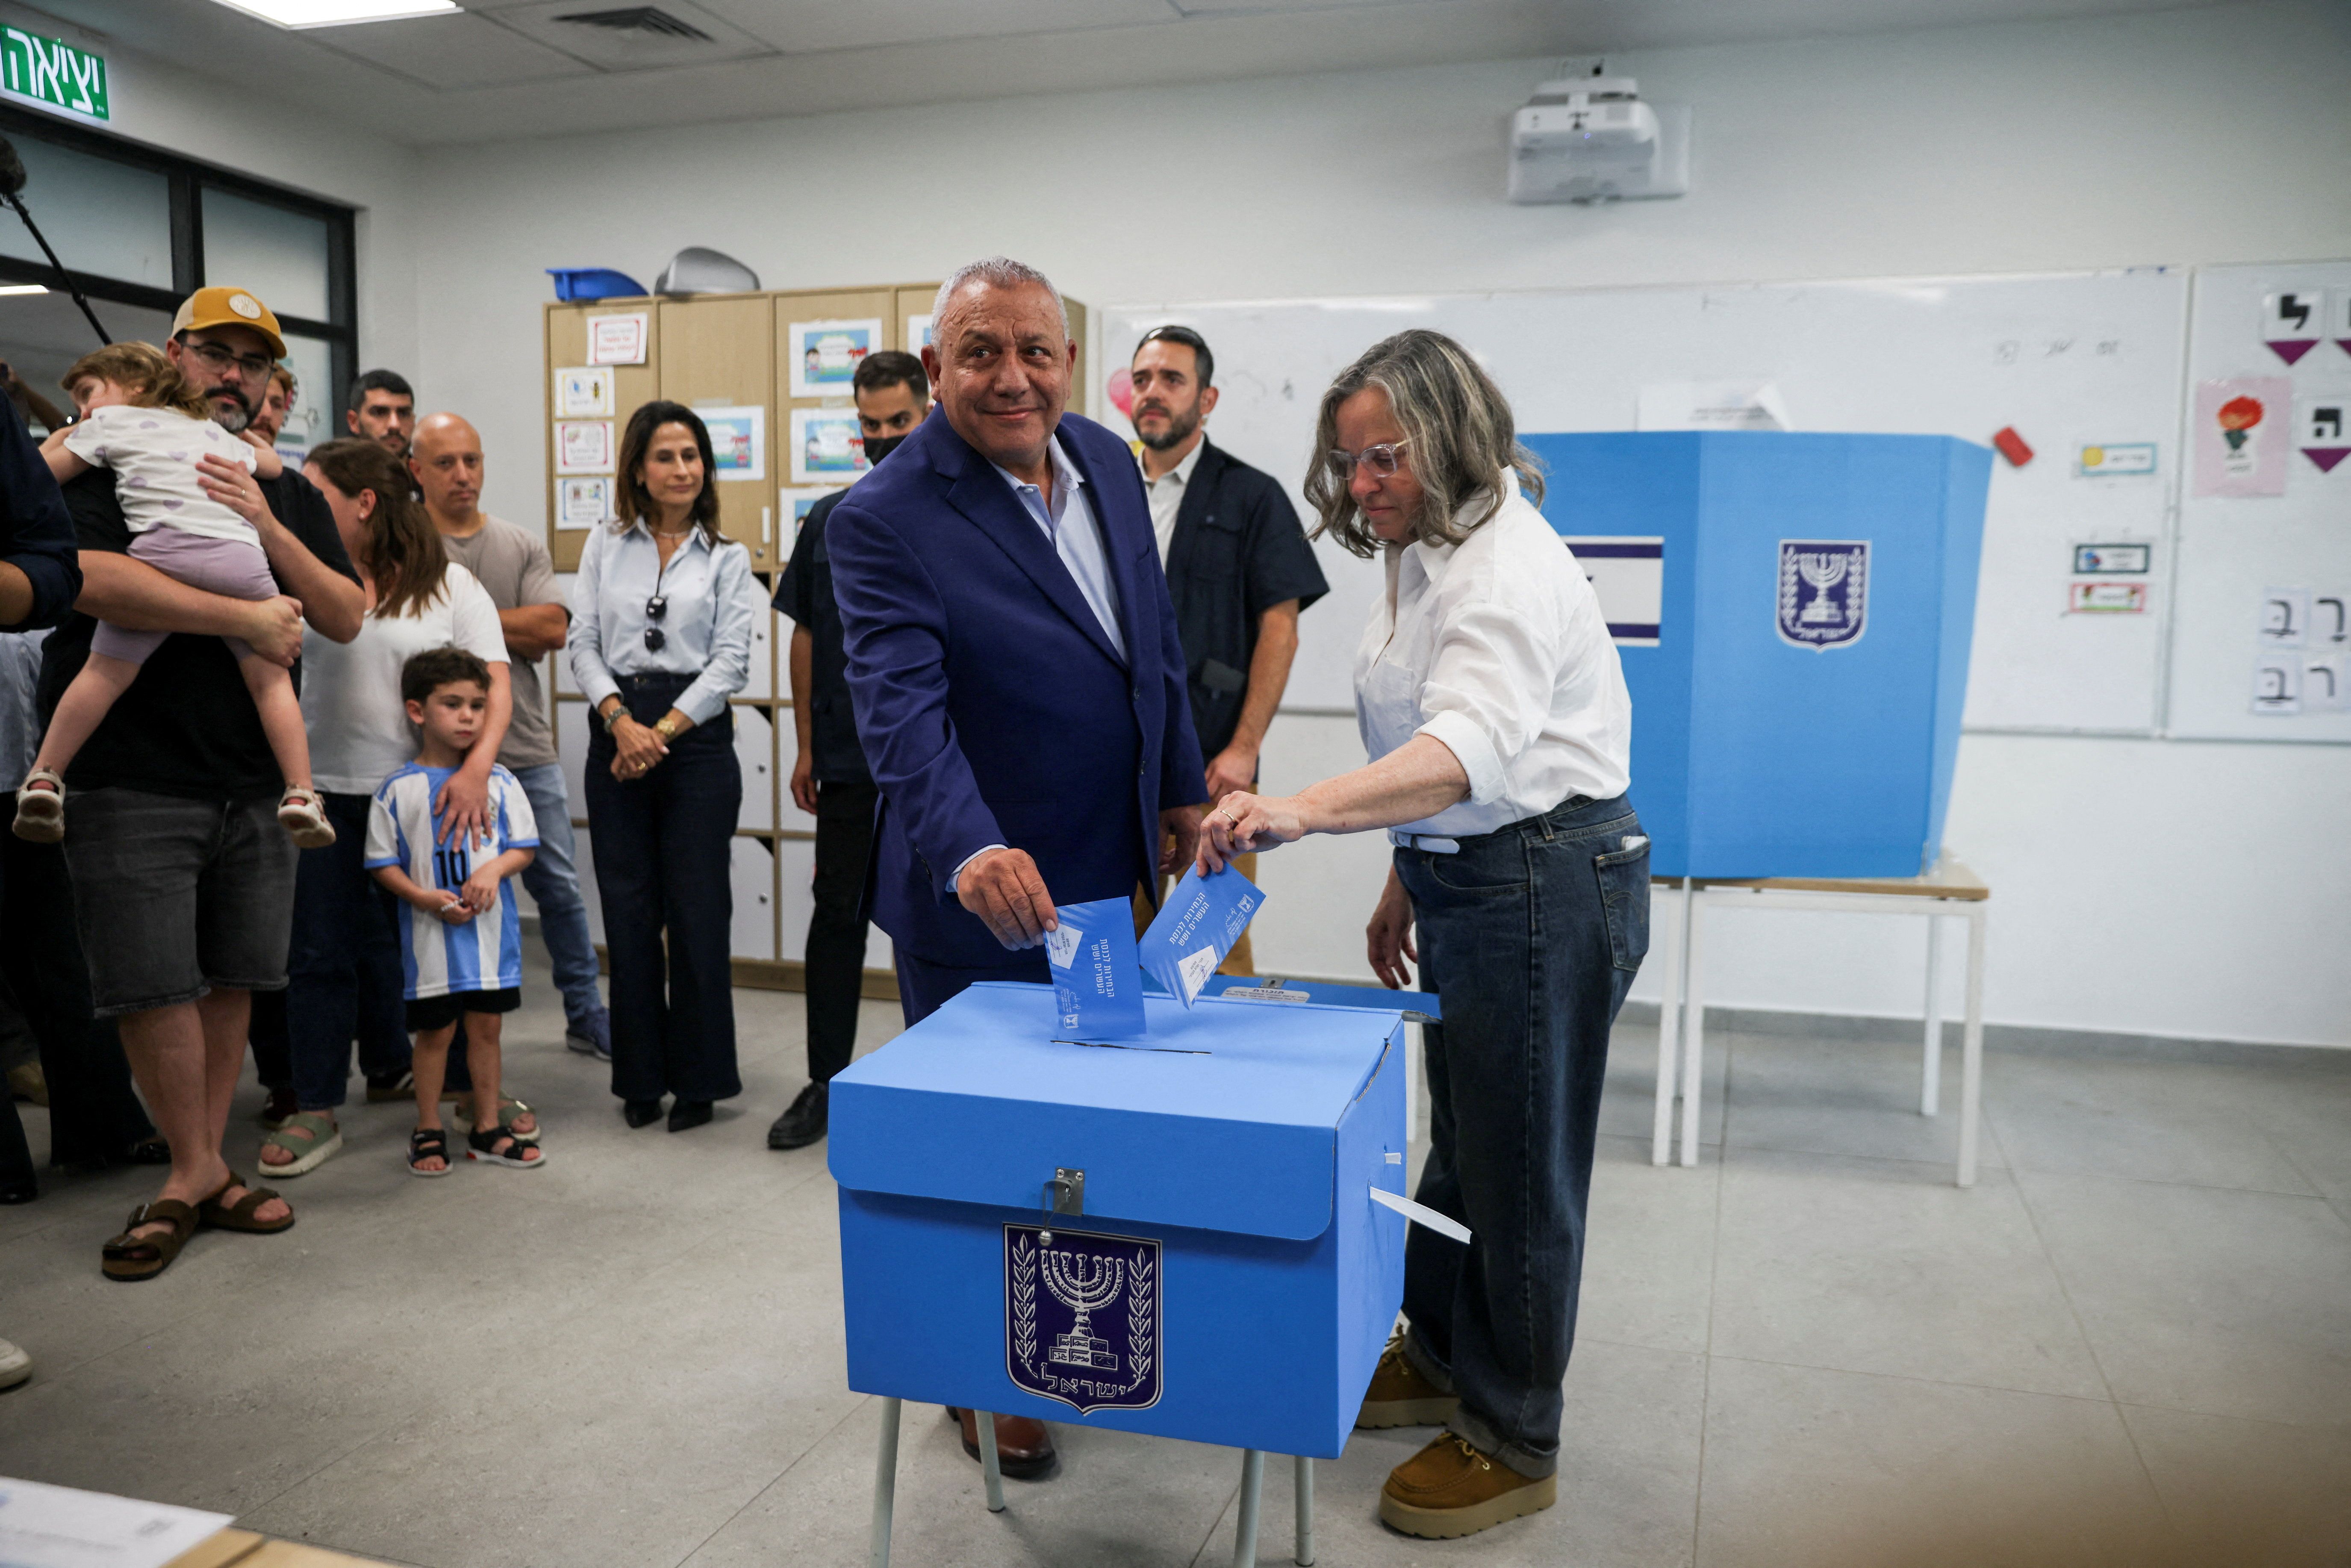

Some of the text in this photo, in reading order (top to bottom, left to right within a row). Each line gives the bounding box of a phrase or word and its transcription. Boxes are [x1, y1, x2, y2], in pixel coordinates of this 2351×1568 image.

[7, 28, 100, 115] יציאה
[2280, 295, 2310, 330] ל
[2313, 408, 2341, 437] ה
[435, 849, 466, 888] 10
[1169, 892, 1205, 945] הבחירות לכנסת
[1178, 902, 1210, 946] העשרים ושש
[1091, 944, 1105, 994] העשרים ושש
[1099, 938, 1114, 997] הבחירות לכנסת
[1041, 1362, 1126, 1398] ישראל
